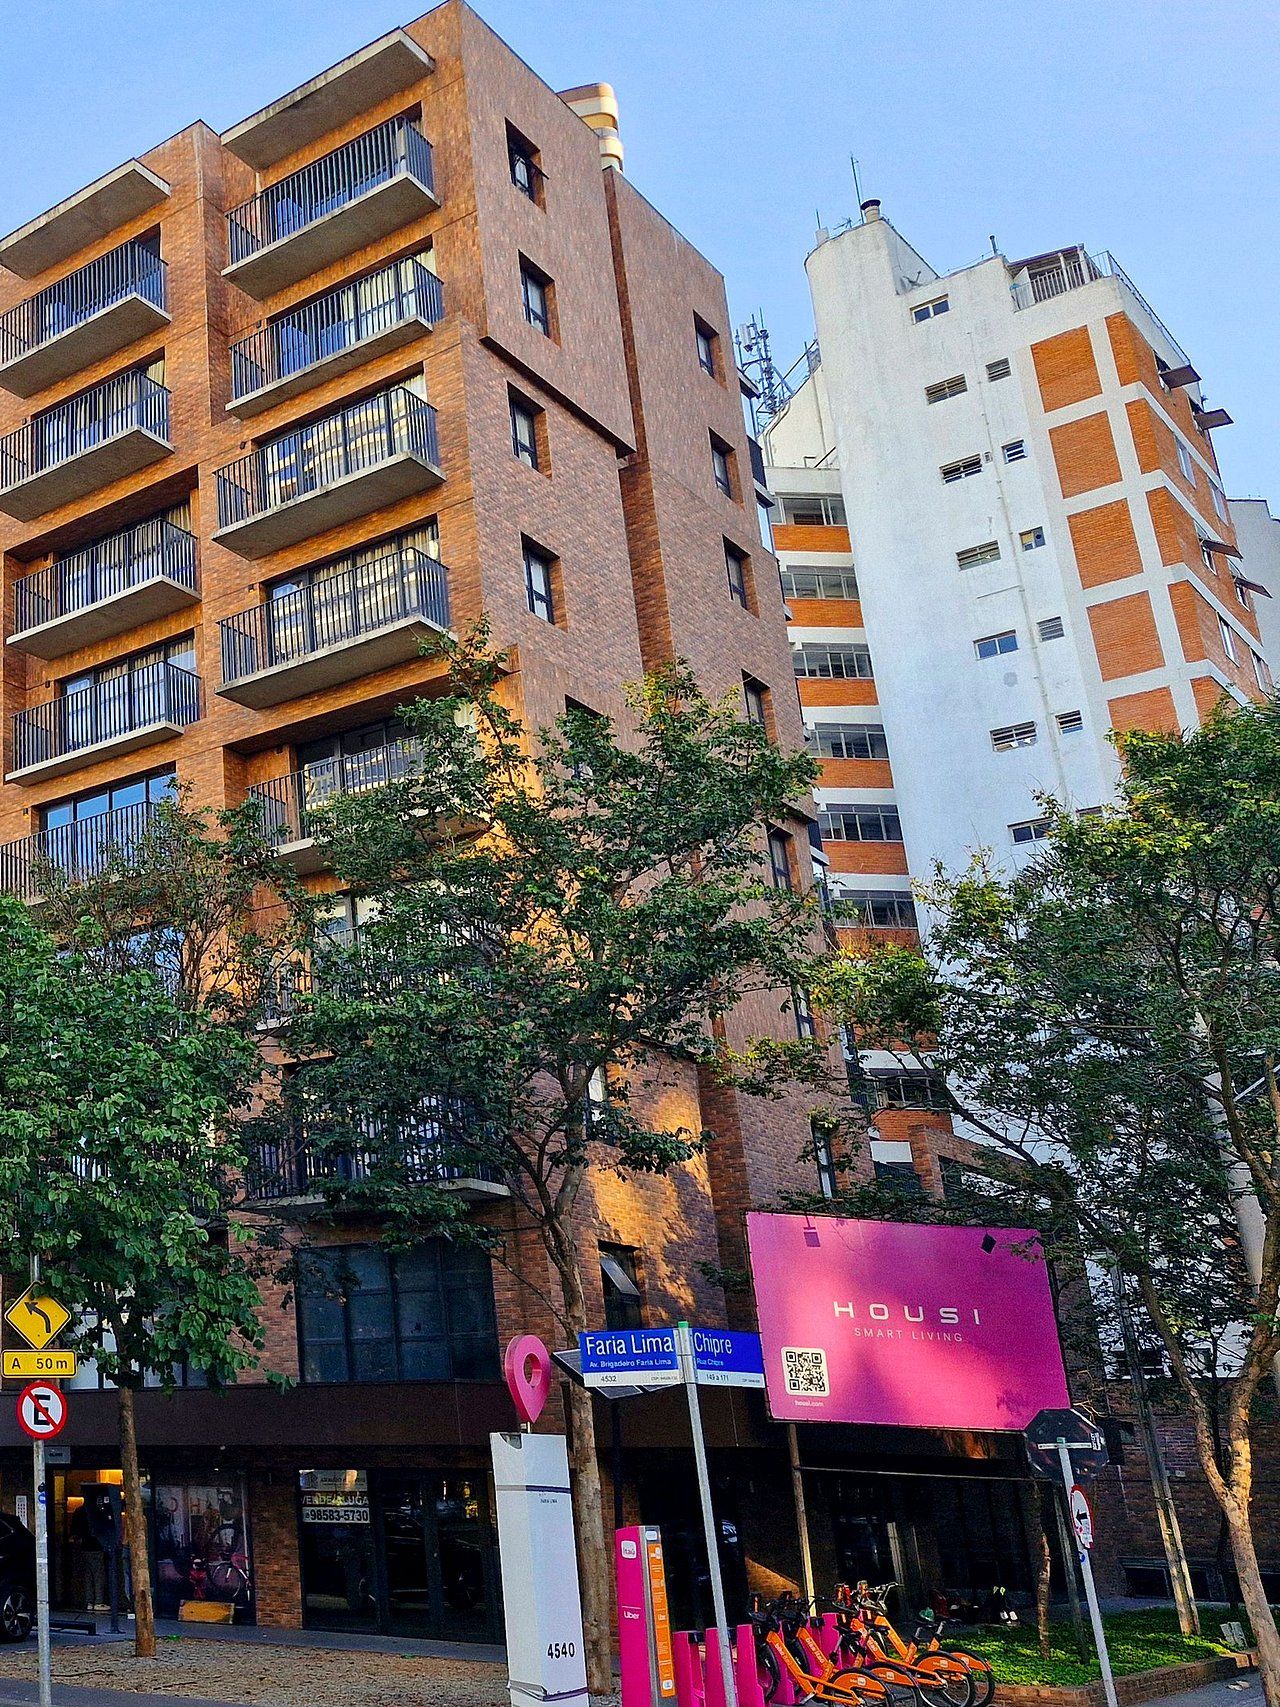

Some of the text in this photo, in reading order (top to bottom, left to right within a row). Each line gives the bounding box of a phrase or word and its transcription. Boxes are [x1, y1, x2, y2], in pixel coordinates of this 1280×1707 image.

[833, 1301, 980, 1325] HOUSI
[854, 1327, 963, 1342] SMART LIVING
[585, 1334, 674, 1355] Faria Lima
[694, 1332, 732, 1357] Chipre
[11, 1357, 21, 1369] A
[600, 1360, 635, 1369] Brigadeiro
[33, 1393, 51, 1425] E
[310, 1509, 369, 1521] 98583-5730
[623, 1610, 640, 1619] Uber
[547, 1642, 575, 1659] 4540
